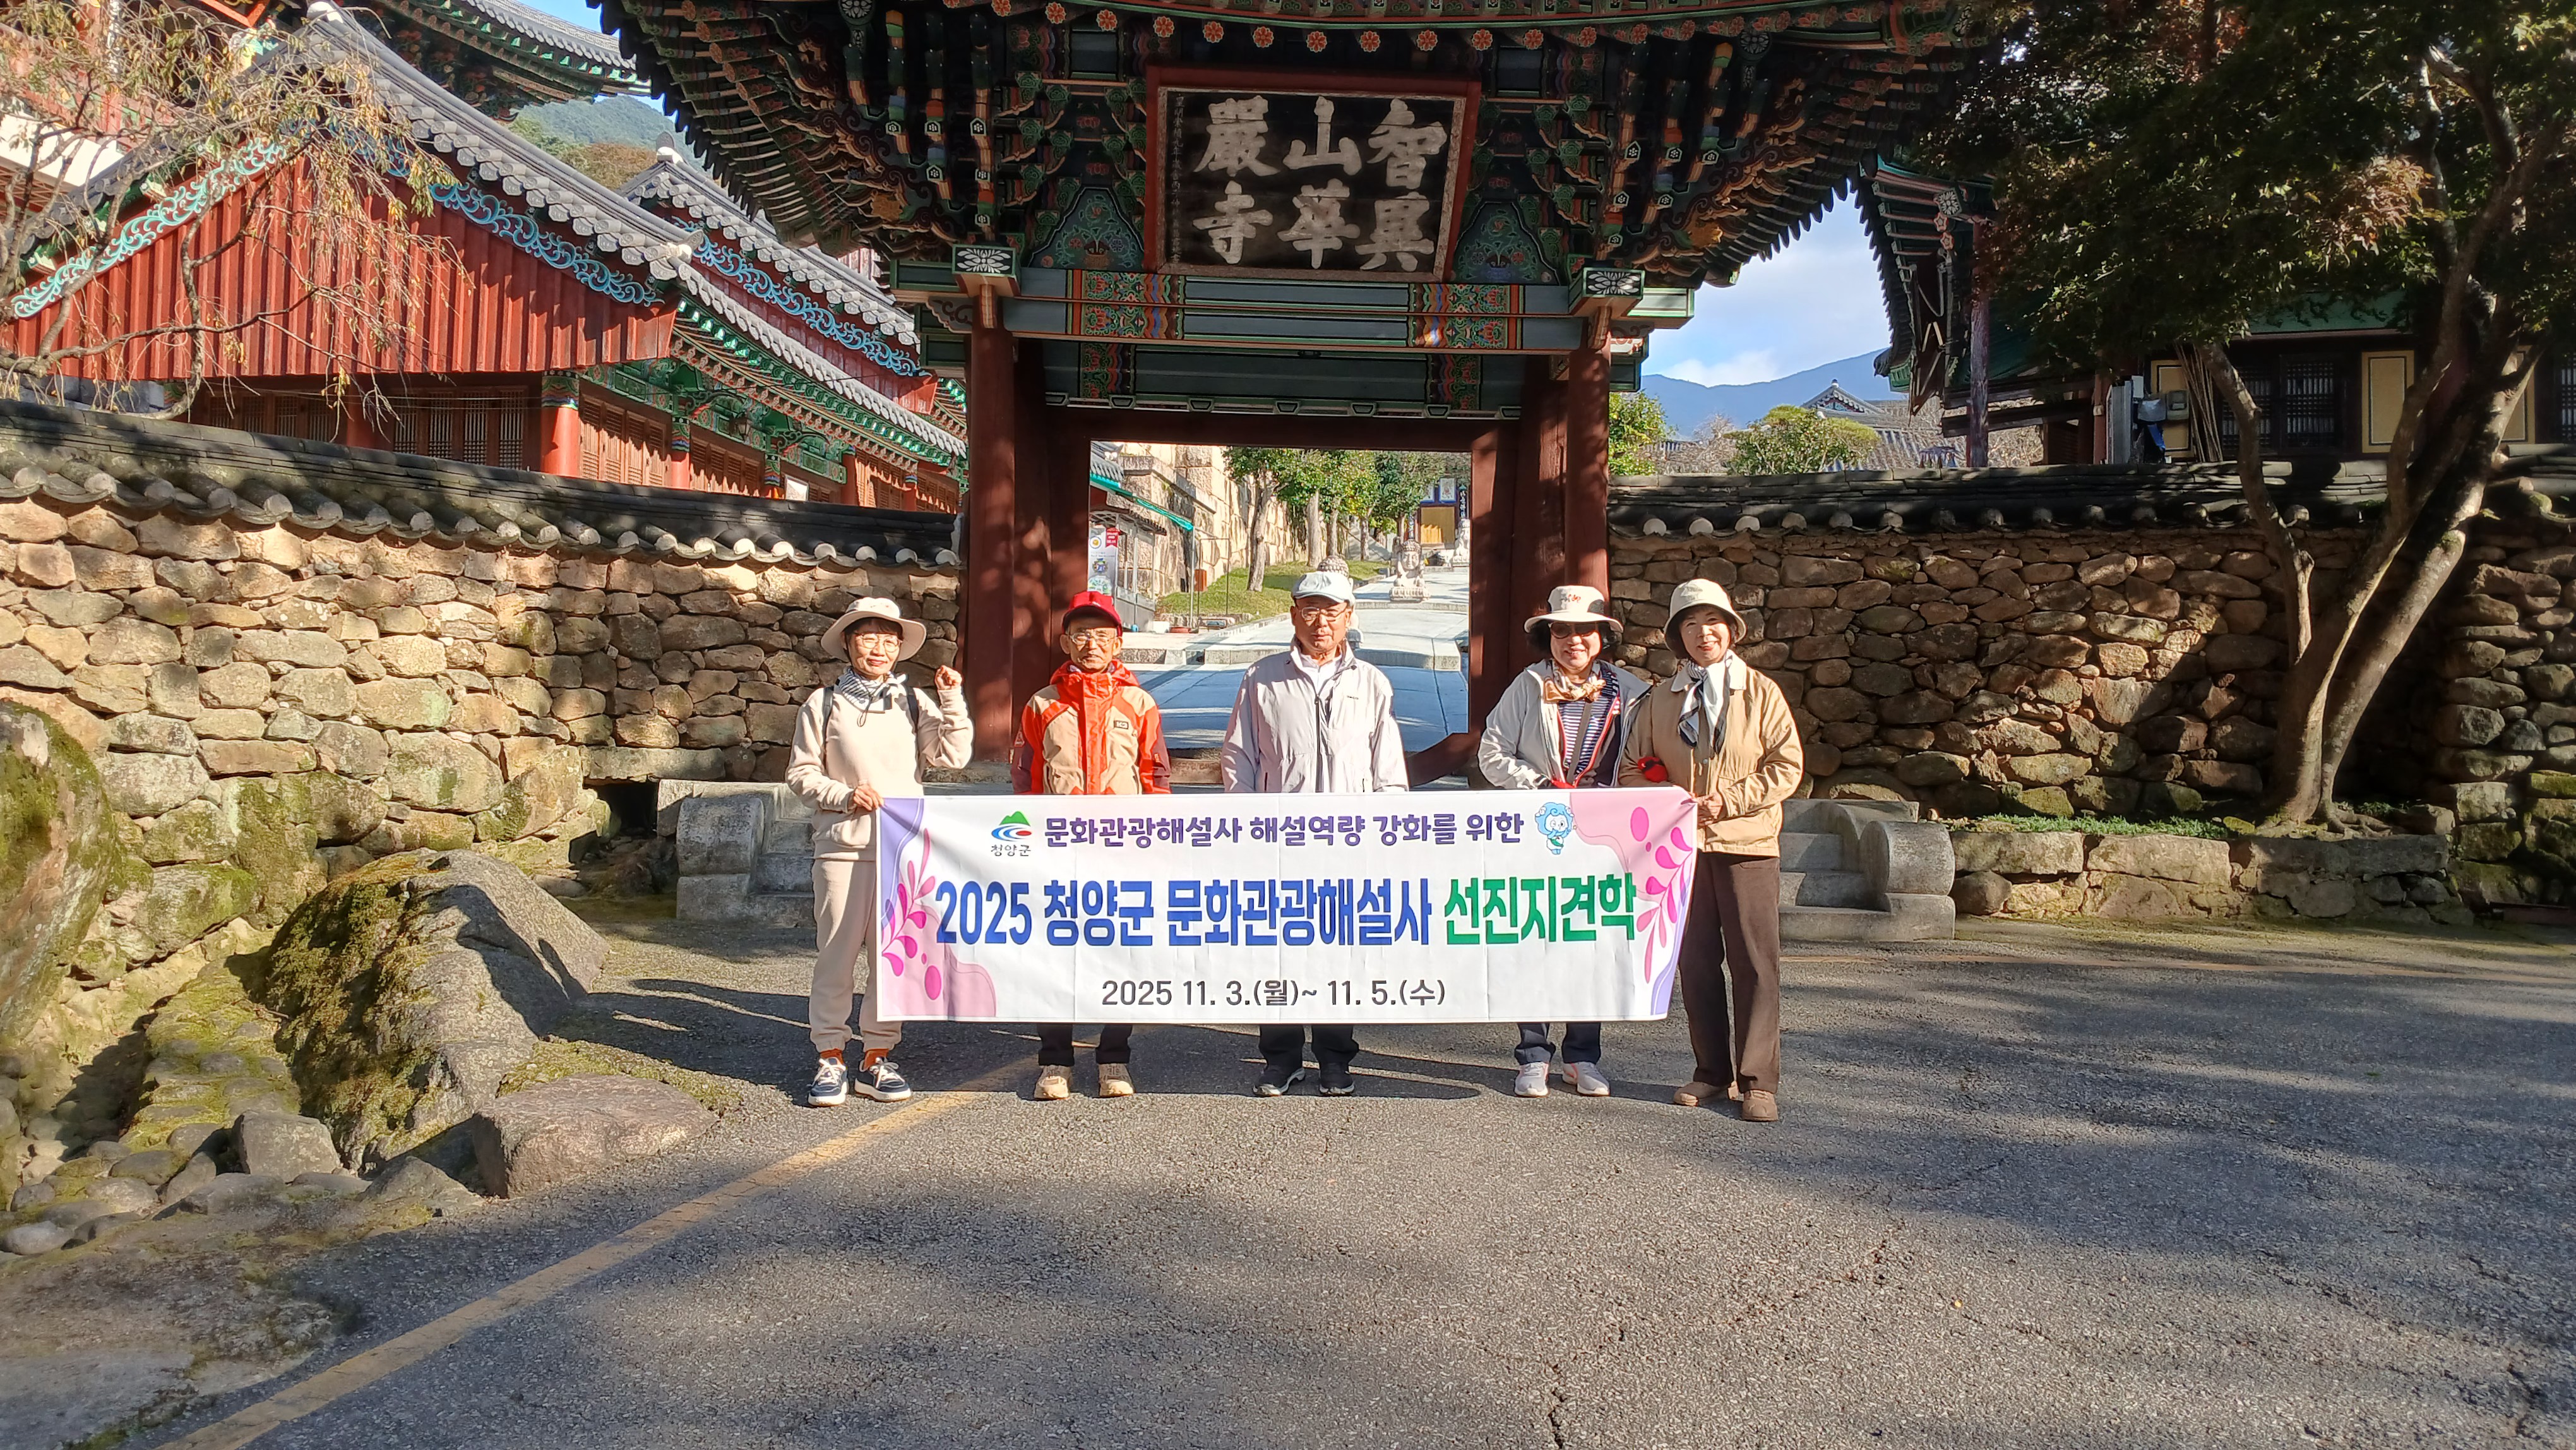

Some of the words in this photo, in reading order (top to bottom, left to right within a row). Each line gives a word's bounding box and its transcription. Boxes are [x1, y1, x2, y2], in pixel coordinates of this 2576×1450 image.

[1044, 817, 1243, 848] 문화관광해설사
[1249, 816, 1366, 846] 해설역량
[1373, 814, 1457, 846] 강화를
[1465, 813, 1524, 843] 위한
[991, 844, 1031, 857] 청양군
[936, 881, 1032, 945] 2025
[1044, 880, 1154, 947] 청양군
[1167, 879, 1432, 946] 문화관광해설사
[1445, 873, 1637, 945] 선진지견학
[1102, 980, 1172, 1005] 2025
[1183, 981, 1215, 1005] 11.
[1226, 980, 1317, 1006] 3.(월)~
[1327, 981, 1361, 1005] 11.
[1371, 980, 1445, 1006] 5.(수)
